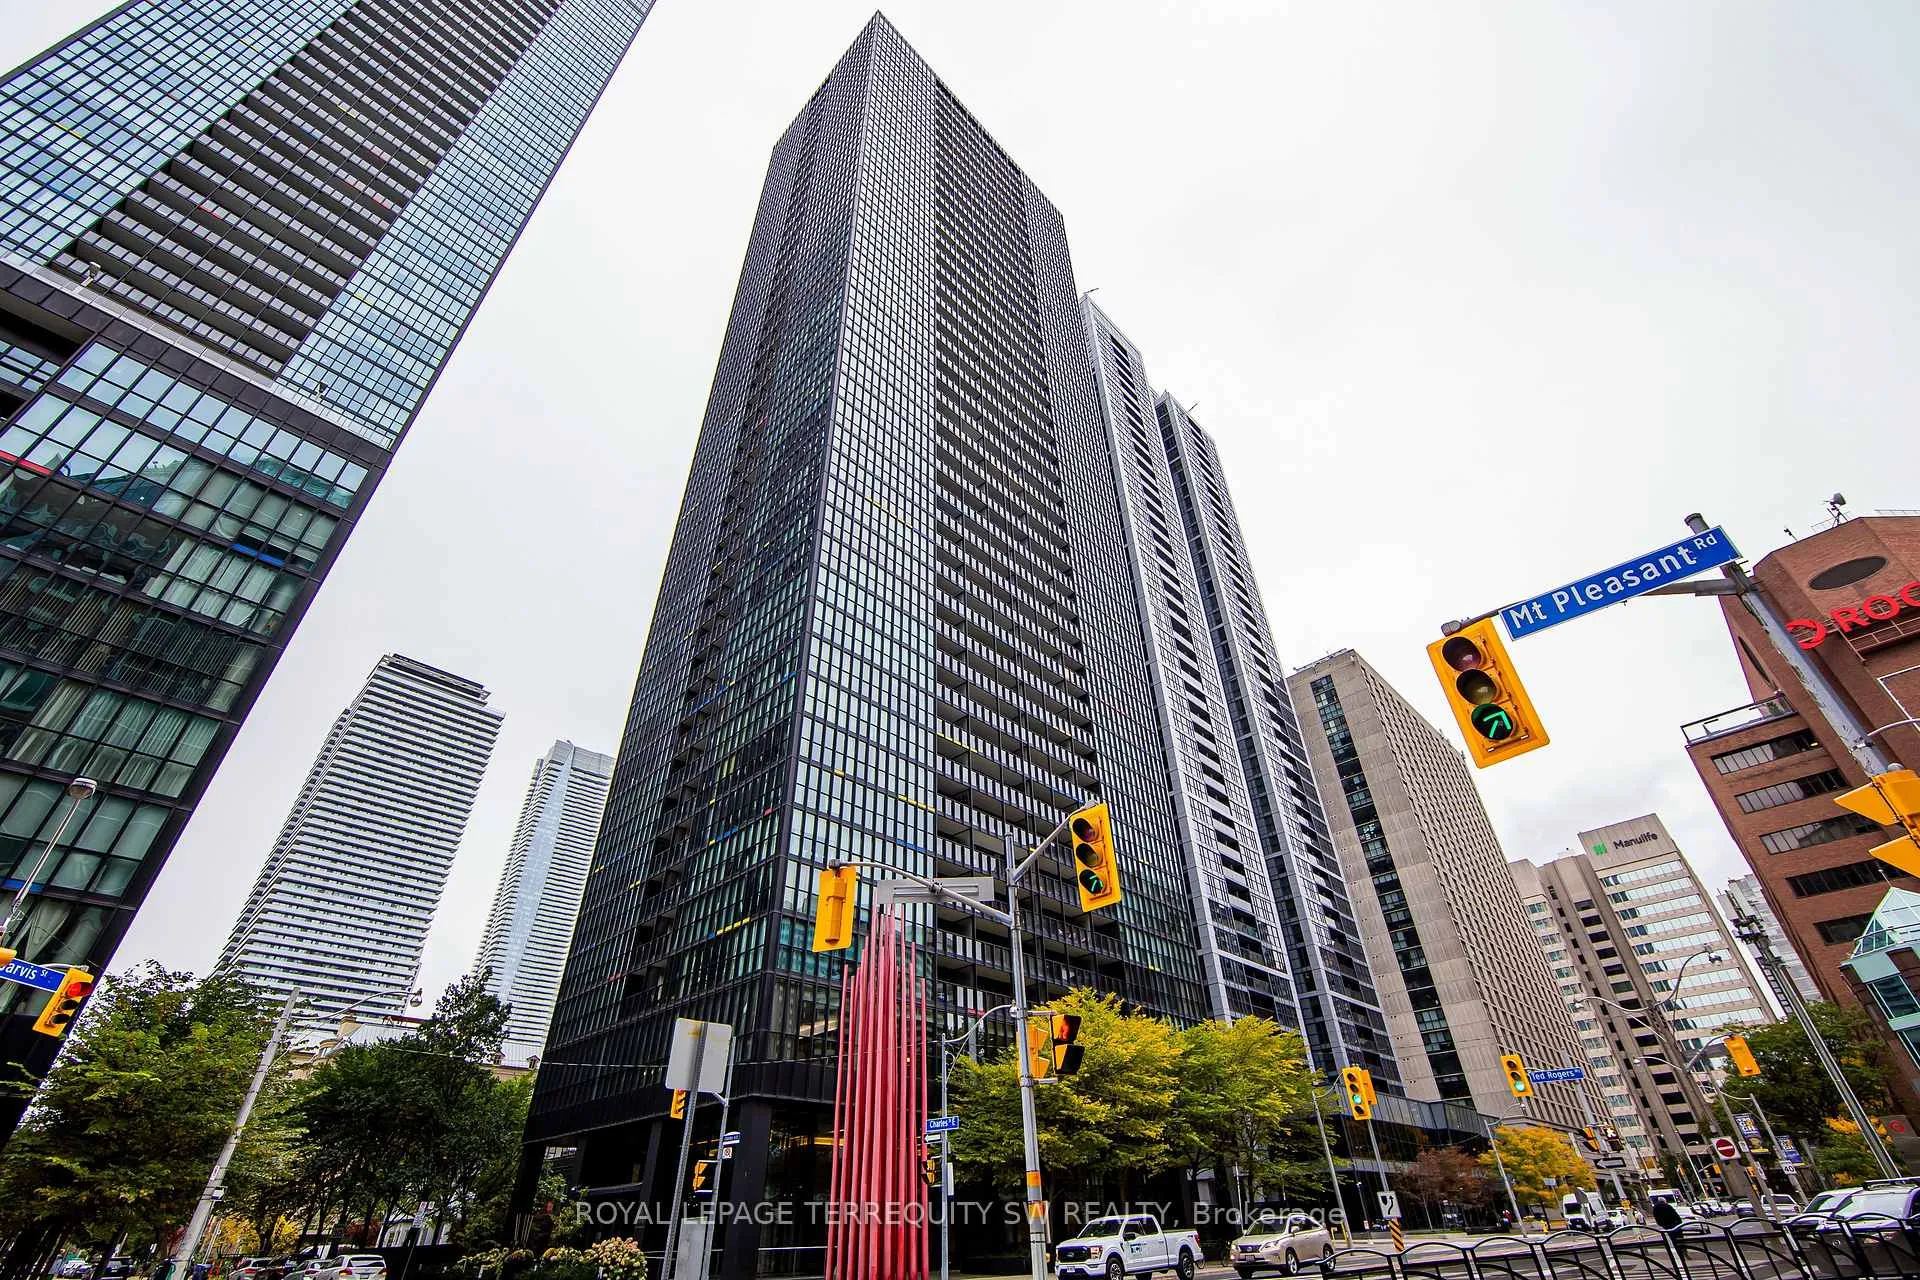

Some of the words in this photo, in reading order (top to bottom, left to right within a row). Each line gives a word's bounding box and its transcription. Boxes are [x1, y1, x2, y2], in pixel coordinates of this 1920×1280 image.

[1509, 601, 1547, 629] Mt
[1551, 546, 1697, 613] Pleasant
[1694, 534, 1718, 550] Rd
[1613, 831, 1658, 849] Manulife
[1547, 1070, 1575, 1080] Rogers
[929, 1120, 948, 1128] Charles
[1784, 1165, 1795, 1173] 40
